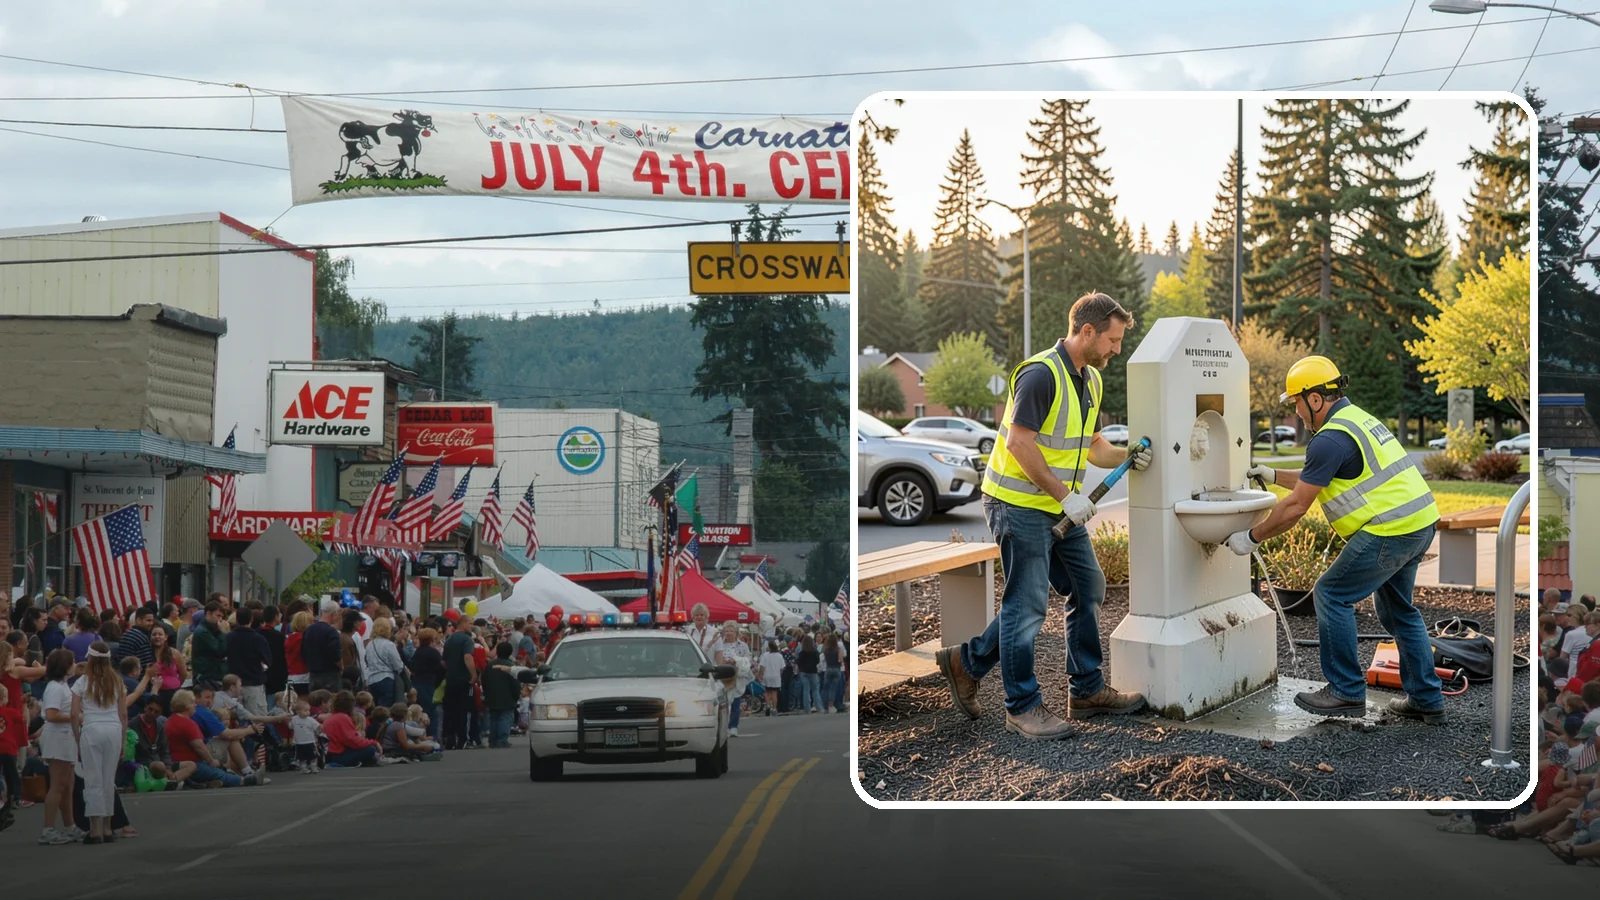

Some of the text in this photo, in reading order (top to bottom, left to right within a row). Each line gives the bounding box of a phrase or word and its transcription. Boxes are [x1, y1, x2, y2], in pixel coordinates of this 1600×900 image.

[695, 121, 850, 150] Carnat
[481, 141, 605, 192] JULY
[632, 150, 746, 198] 4th.
[696, 254, 850, 280] CROSSWA
[283, 380, 373, 420] ACE
[283, 421, 371, 437] Hardware
[353, 467, 386, 480] Simpl
[95, 485, 124, 495] Vincent
[126, 486, 136, 495] de
[137, 486, 155, 495] Paul
[688, 526, 742, 535] CRNATION
[699, 535, 730, 543] GLASS
